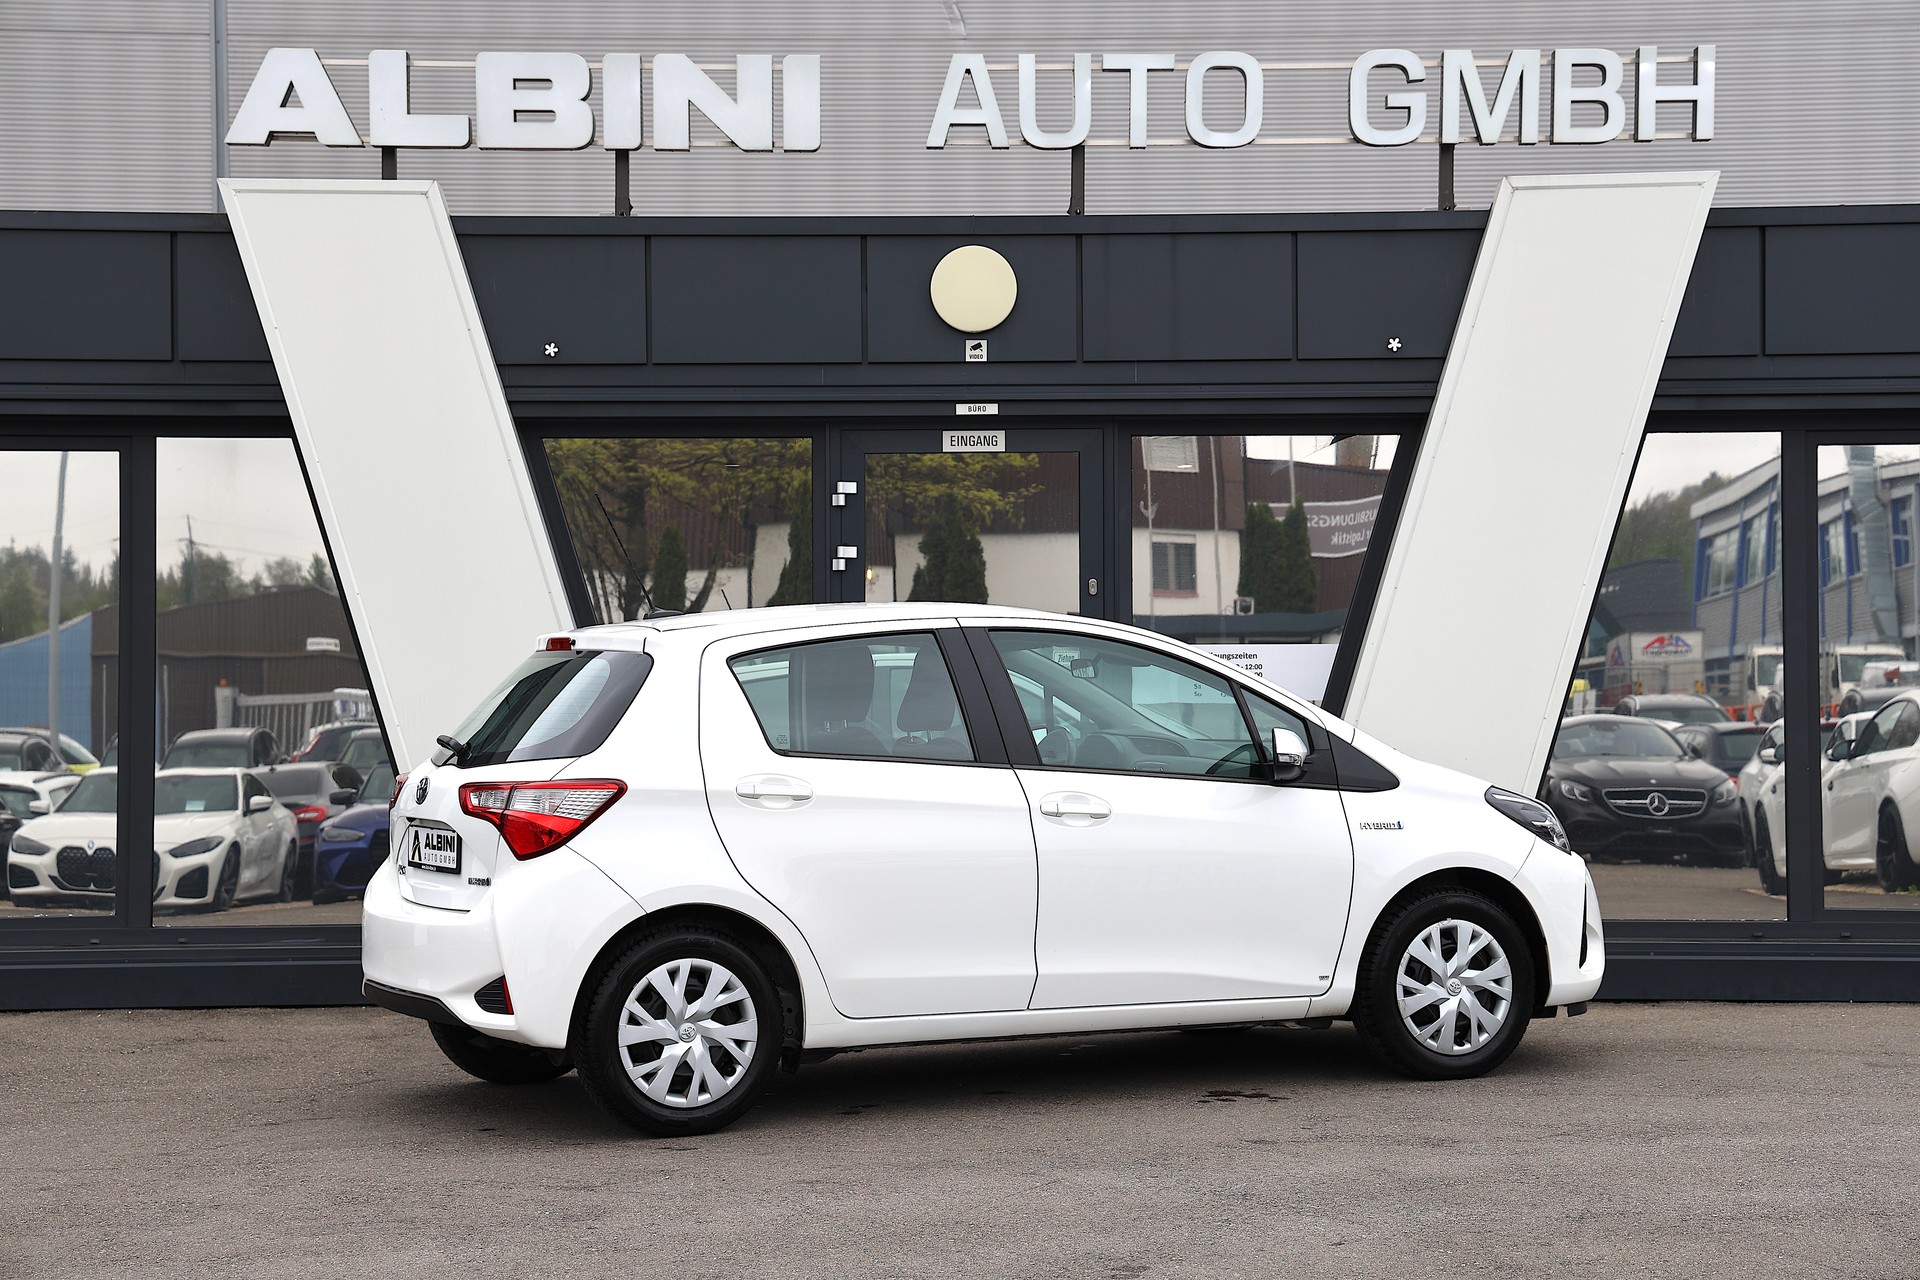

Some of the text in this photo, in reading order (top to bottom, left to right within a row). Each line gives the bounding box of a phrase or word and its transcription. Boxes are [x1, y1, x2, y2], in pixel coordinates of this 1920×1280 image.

[225, 45, 1717, 152] ALBINI AUTO GMBH
[950, 435, 998, 447] EINGANG
[1360, 822, 1396, 830] HYBRID
[424, 833, 456, 853] ALBINI
[424, 854, 456, 865] AUTO GMBH
